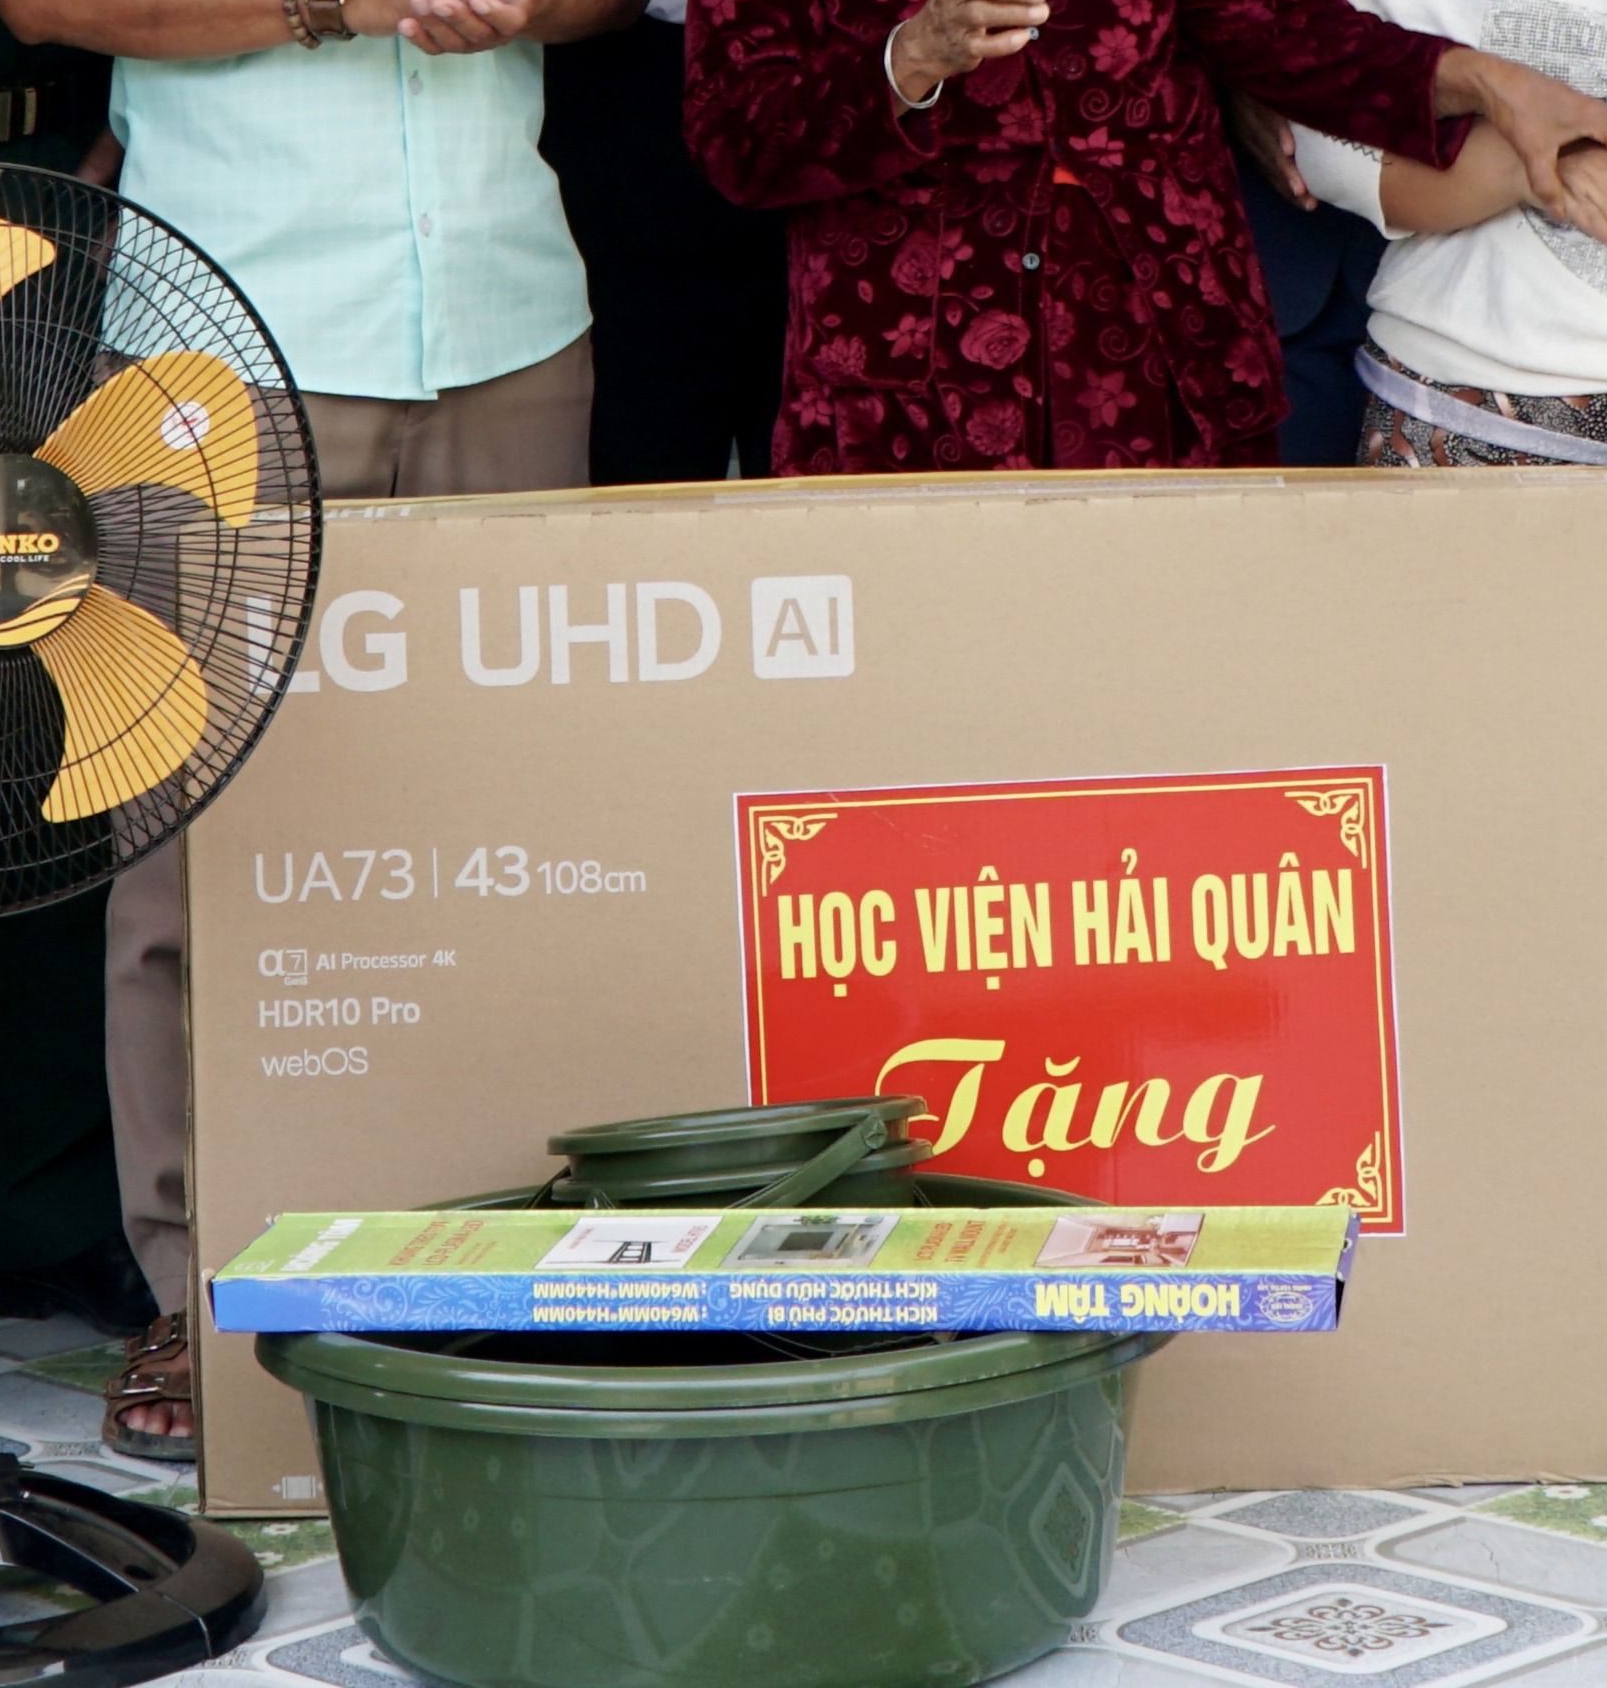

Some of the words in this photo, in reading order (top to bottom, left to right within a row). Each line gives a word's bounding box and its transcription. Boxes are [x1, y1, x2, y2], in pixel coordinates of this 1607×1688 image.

[0, 555, 26, 563] COOL
[28, 554, 50, 563] LIFE
[246, 590, 408, 693] LG
[460, 581, 722, 687] UHD
[765, 596, 841, 658] AI
[255, 848, 415, 904] UA73
[454, 845, 531, 897] 43
[537, 860, 646, 895] 108cm
[777, 889, 897, 997] HỌC
[914, 865, 1053, 990] VIỆN
[1071, 848, 1171, 966] HẢI
[1192, 852, 1356, 971] QUÂN
[315, 952, 337, 971] AI
[341, 952, 427, 970] Processor
[432, 949, 457, 968] 4K
[259, 997, 361, 1028] HDR10
[371, 996, 421, 1025] Pro
[261, 1046, 369, 1077] webOS
[875, 1038, 1276, 1178] Tặng
[729, 1280, 782, 1299] DỤNG
[786, 1282, 826, 1300] HỮU
[829, 1282, 892, 1300] THƯỚC
[896, 1282, 939, 1300] KÍCH
[1035, 1283, 1110, 1324] TÂM
[1121, 1284, 1240, 1324] HOÀNG
[768, 1305, 785, 1323] BÌ
[787, 1305, 827, 1323] PHỦ
[829, 1305, 892, 1323] THƯỚC
[896, 1305, 939, 1323] KÍCH
